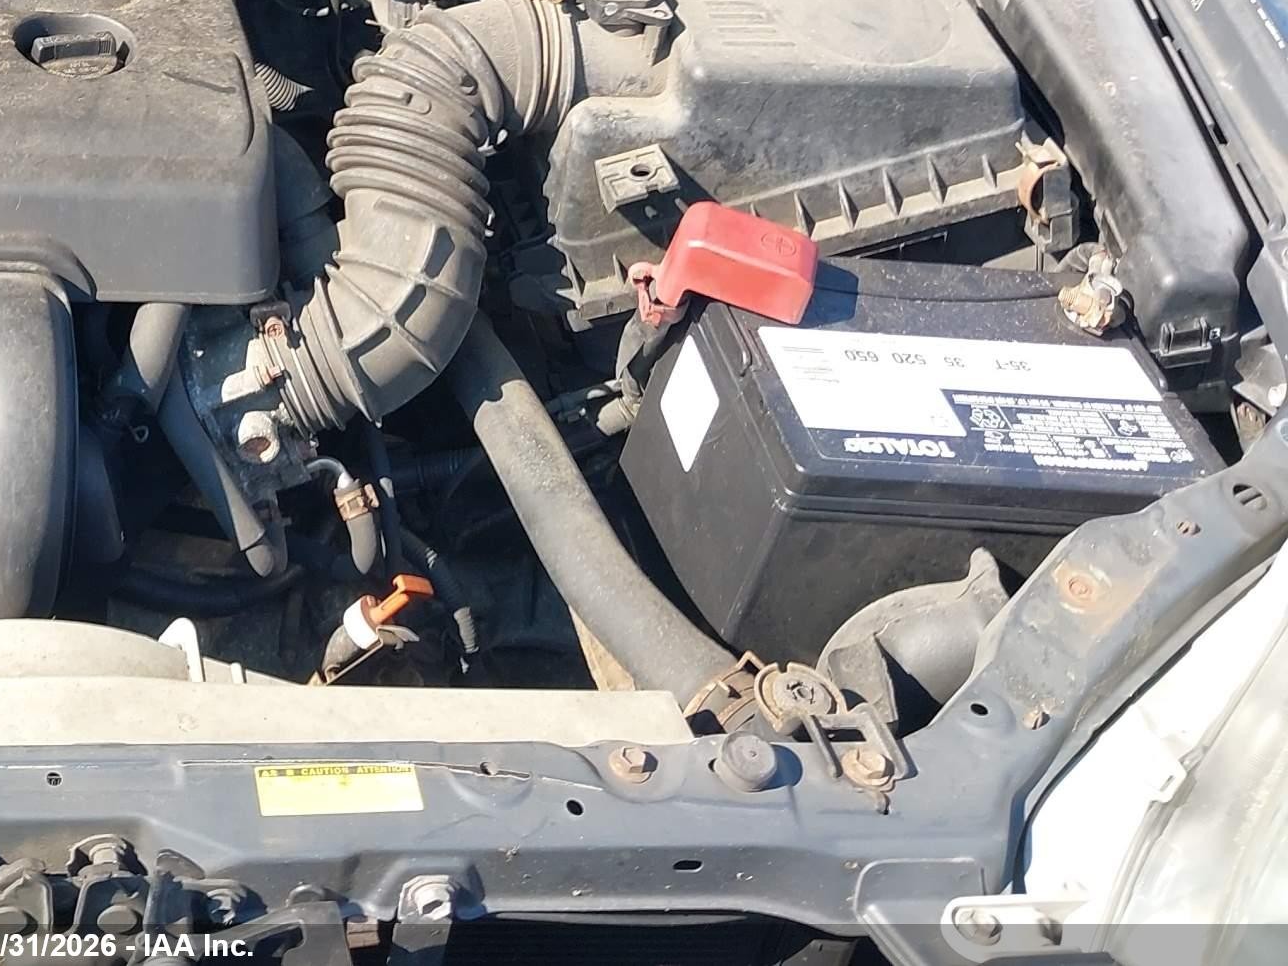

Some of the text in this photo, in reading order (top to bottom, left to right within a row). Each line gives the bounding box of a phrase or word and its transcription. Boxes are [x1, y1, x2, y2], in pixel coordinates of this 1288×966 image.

[844, 349, 1032, 372] 35-T 35 520 650
